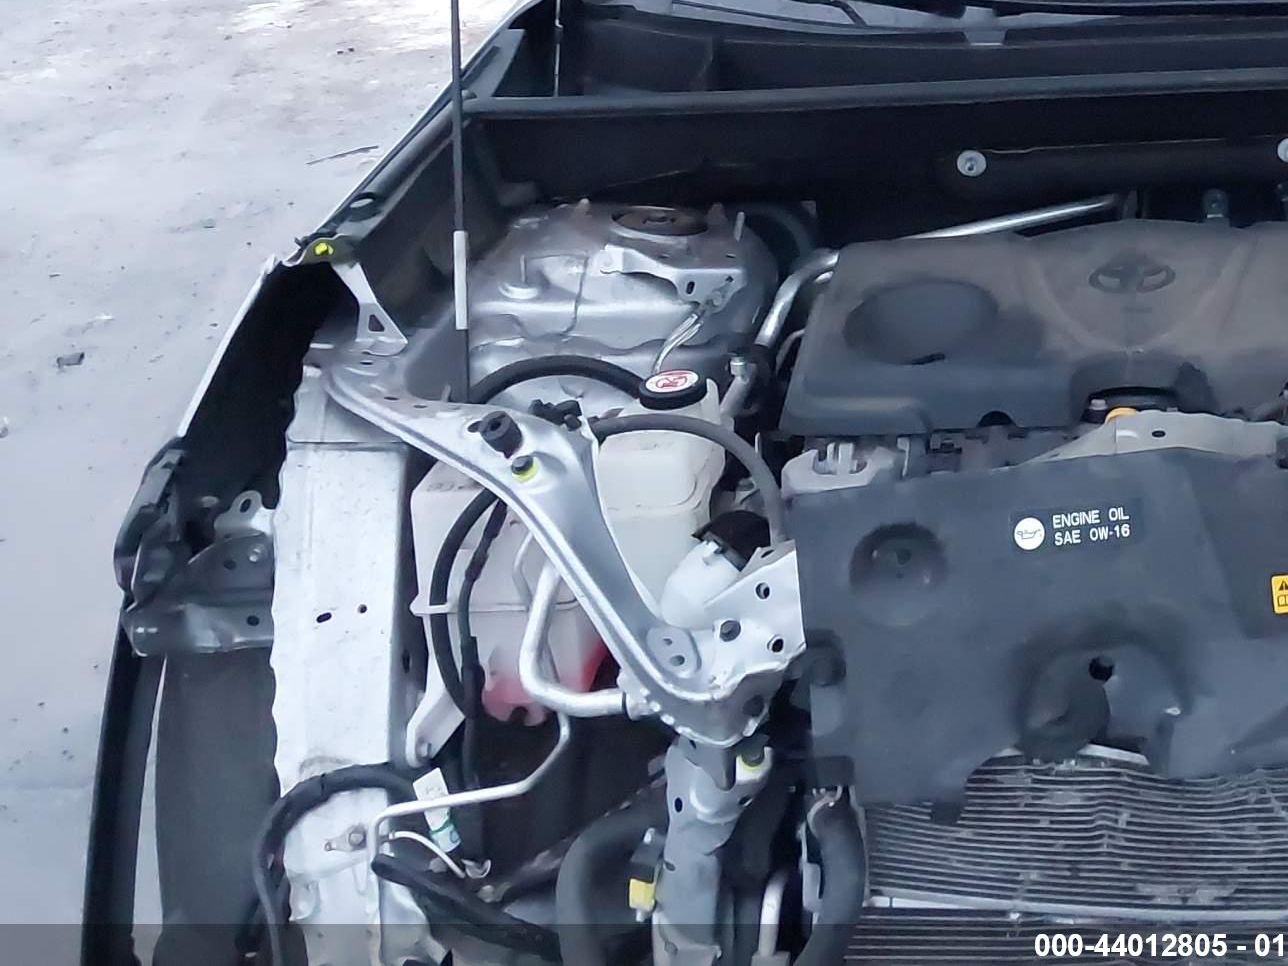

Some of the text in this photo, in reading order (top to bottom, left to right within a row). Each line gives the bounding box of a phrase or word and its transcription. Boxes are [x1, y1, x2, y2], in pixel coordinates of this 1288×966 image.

[1052, 506, 1130, 529] ENGINE OIL
[1054, 528, 1082, 546] SAE
